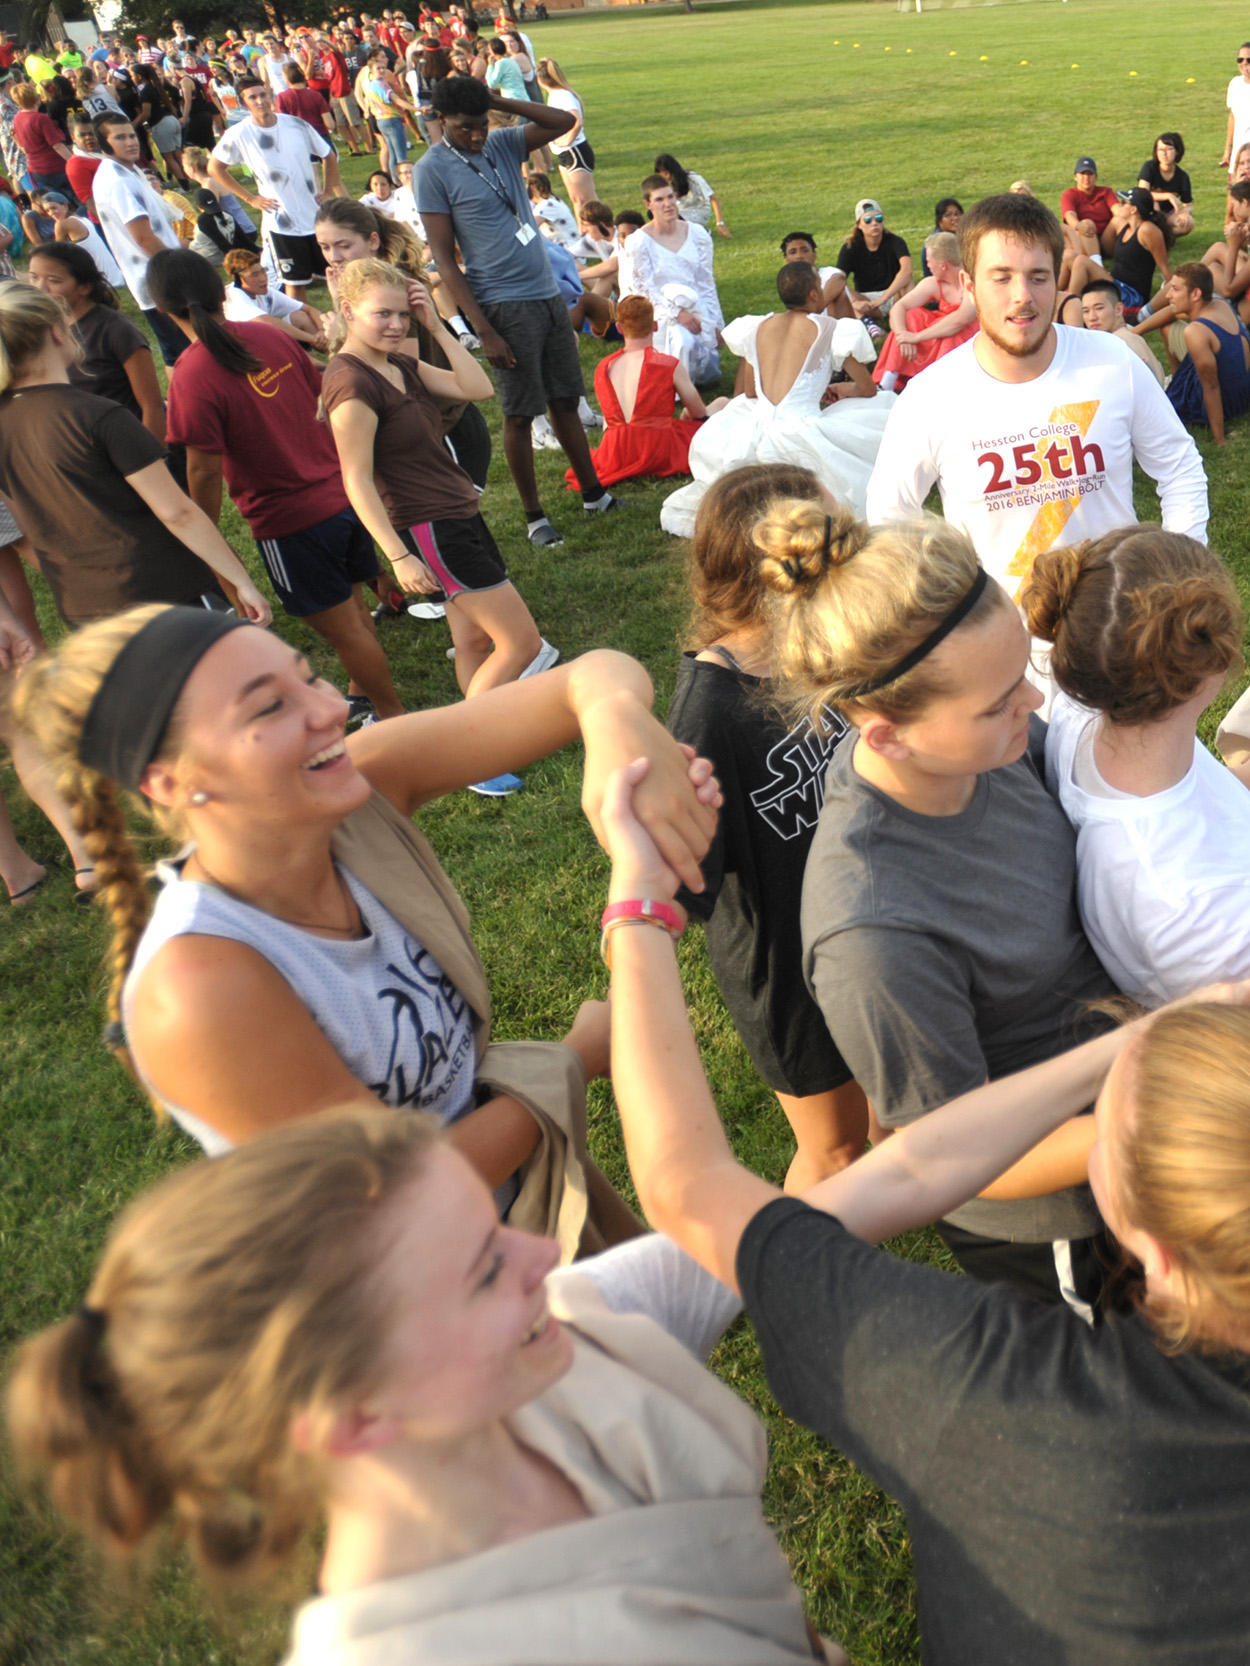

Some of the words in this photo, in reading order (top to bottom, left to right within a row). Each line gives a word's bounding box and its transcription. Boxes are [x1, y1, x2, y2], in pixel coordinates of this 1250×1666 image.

[87, 97, 107, 113] 13
[971, 433, 1025, 451] Hesston
[1028, 423, 1077, 439] College
[977, 435, 1106, 494] 25th
[984, 487, 1030, 502] Anniversary
[1032, 481, 1056, 493] 2-Mile
[986, 498, 1014, 512] 2016
[1016, 487, 1075, 508] BENJAMIN
[1078, 480, 1106, 496] BOLT
[749, 703, 851, 808] STA
